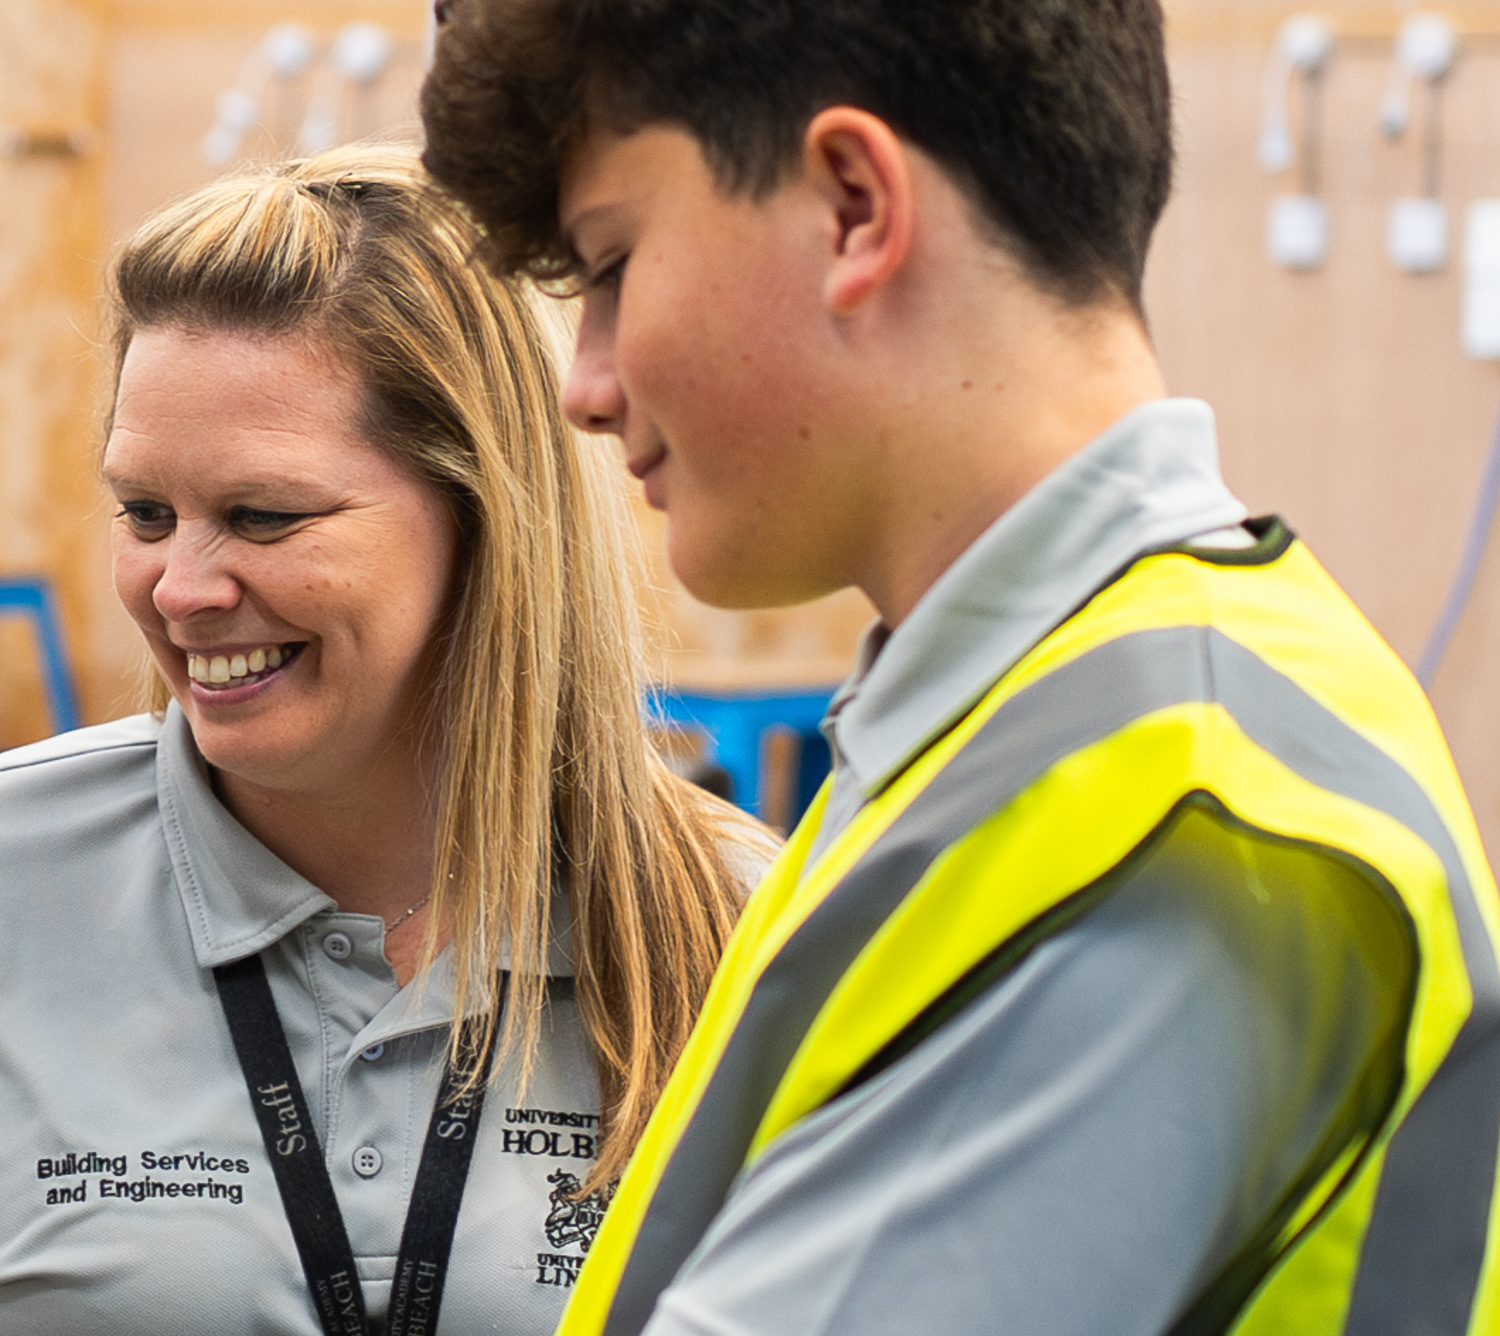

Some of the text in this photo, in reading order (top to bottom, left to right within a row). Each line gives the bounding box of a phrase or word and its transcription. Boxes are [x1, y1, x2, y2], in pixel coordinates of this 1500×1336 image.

[257, 1080, 306, 1155] Staff
[501, 1129, 600, 1160] HOLB
[37, 1151, 250, 1179] Building Services
[46, 1175, 243, 1205] and Engineering
[396, 1258, 414, 1315] ACADEMY
